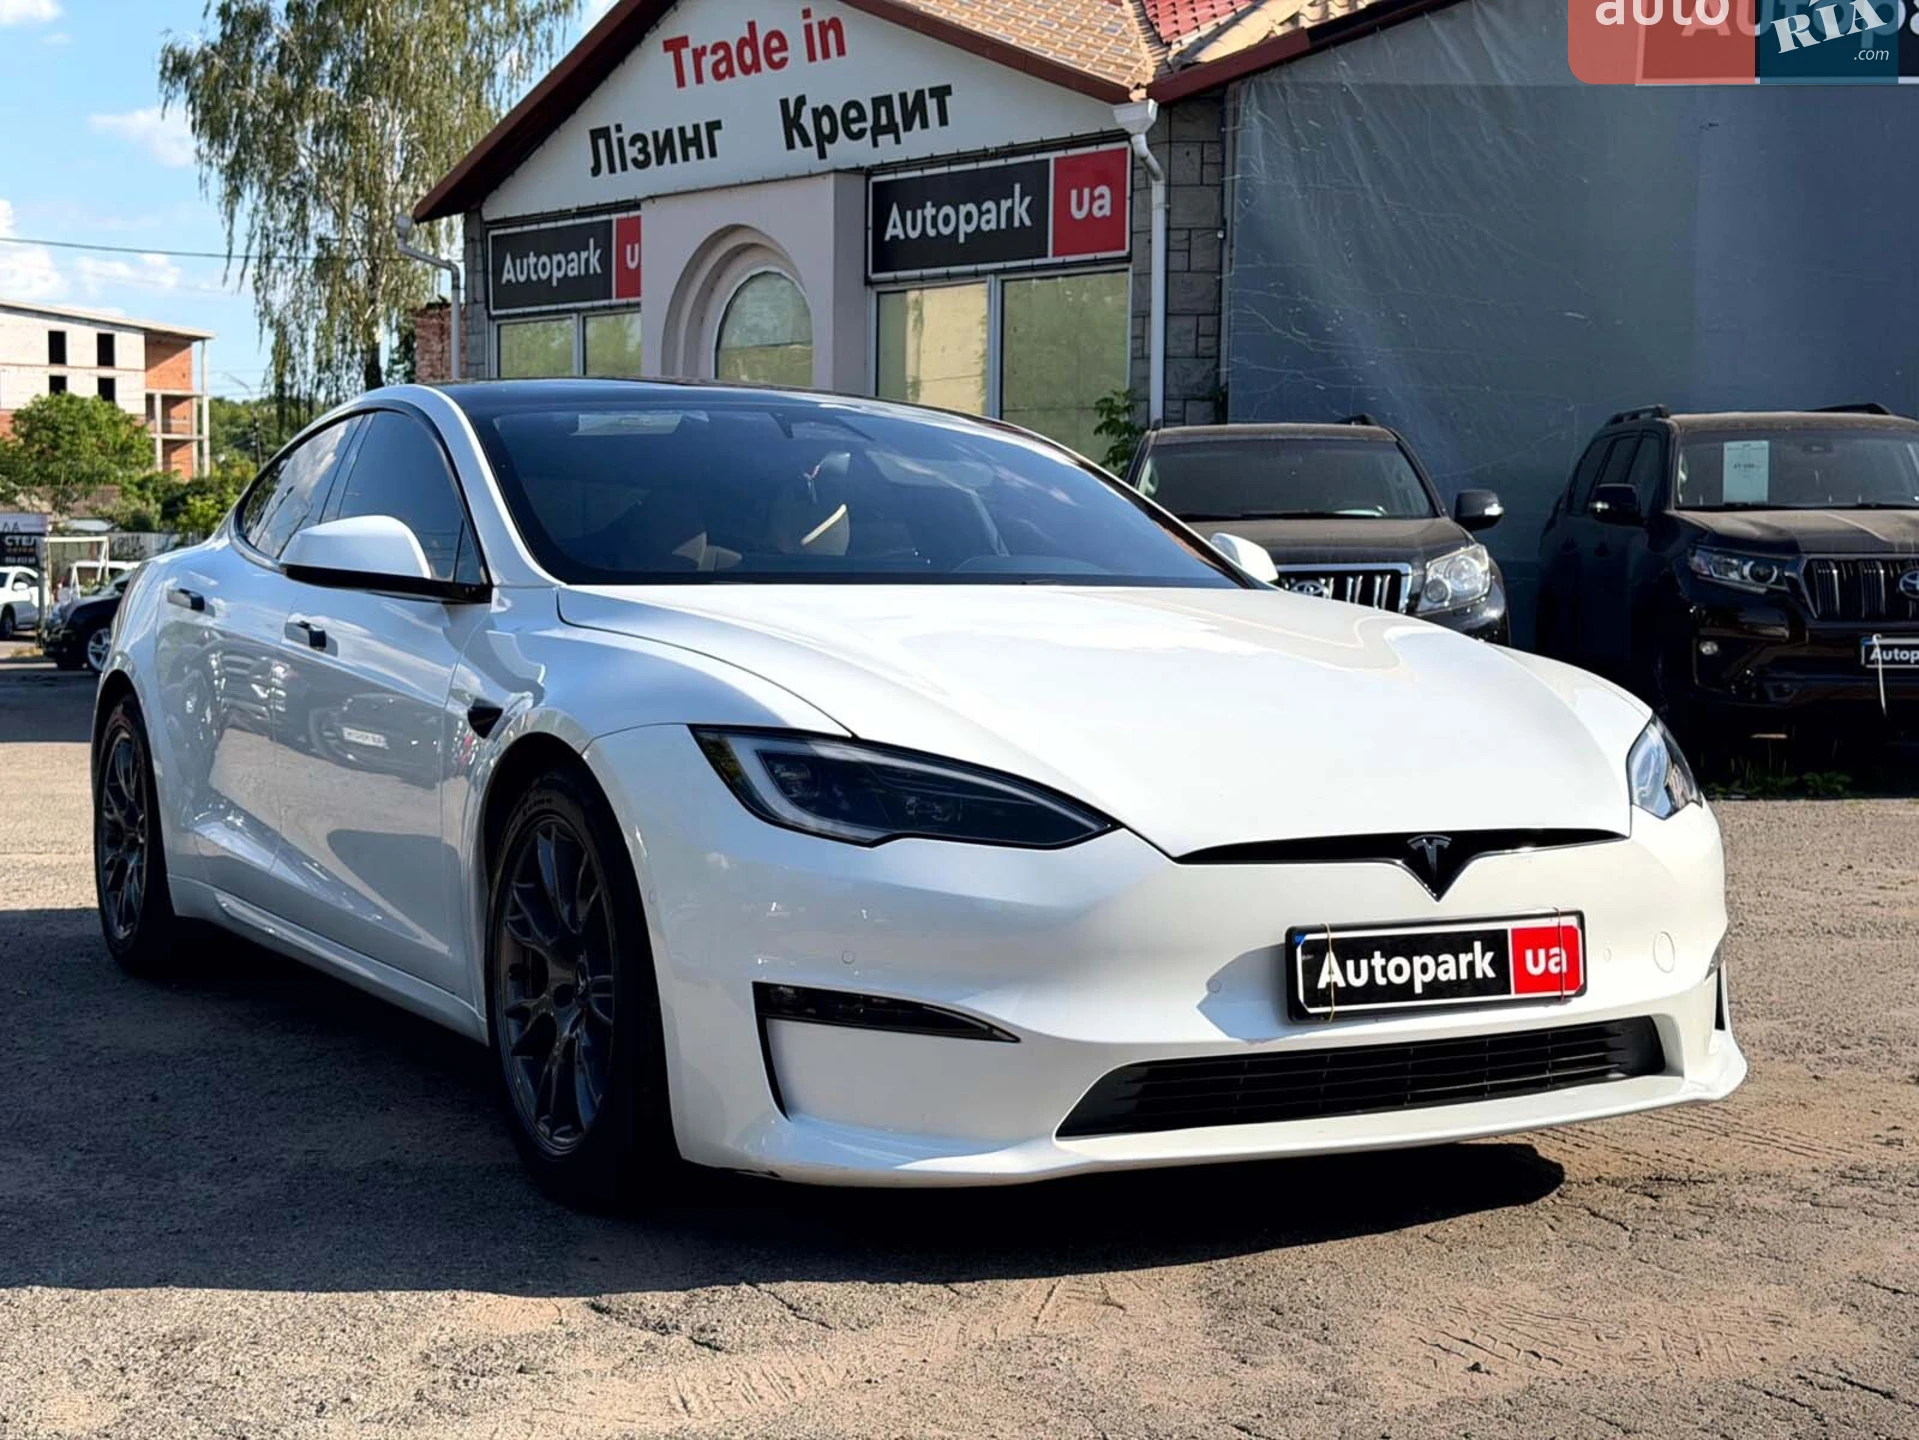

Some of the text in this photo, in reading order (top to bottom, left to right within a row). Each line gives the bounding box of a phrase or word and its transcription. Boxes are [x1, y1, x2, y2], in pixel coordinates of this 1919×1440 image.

[662, 8, 846, 89] Trade in
[589, 84, 953, 177] Лізинг Кредит
[884, 183, 1112, 243] Autopark ua
[501, 237, 602, 287] Autopark
[1317, 941, 1568, 994] Autopark ua
